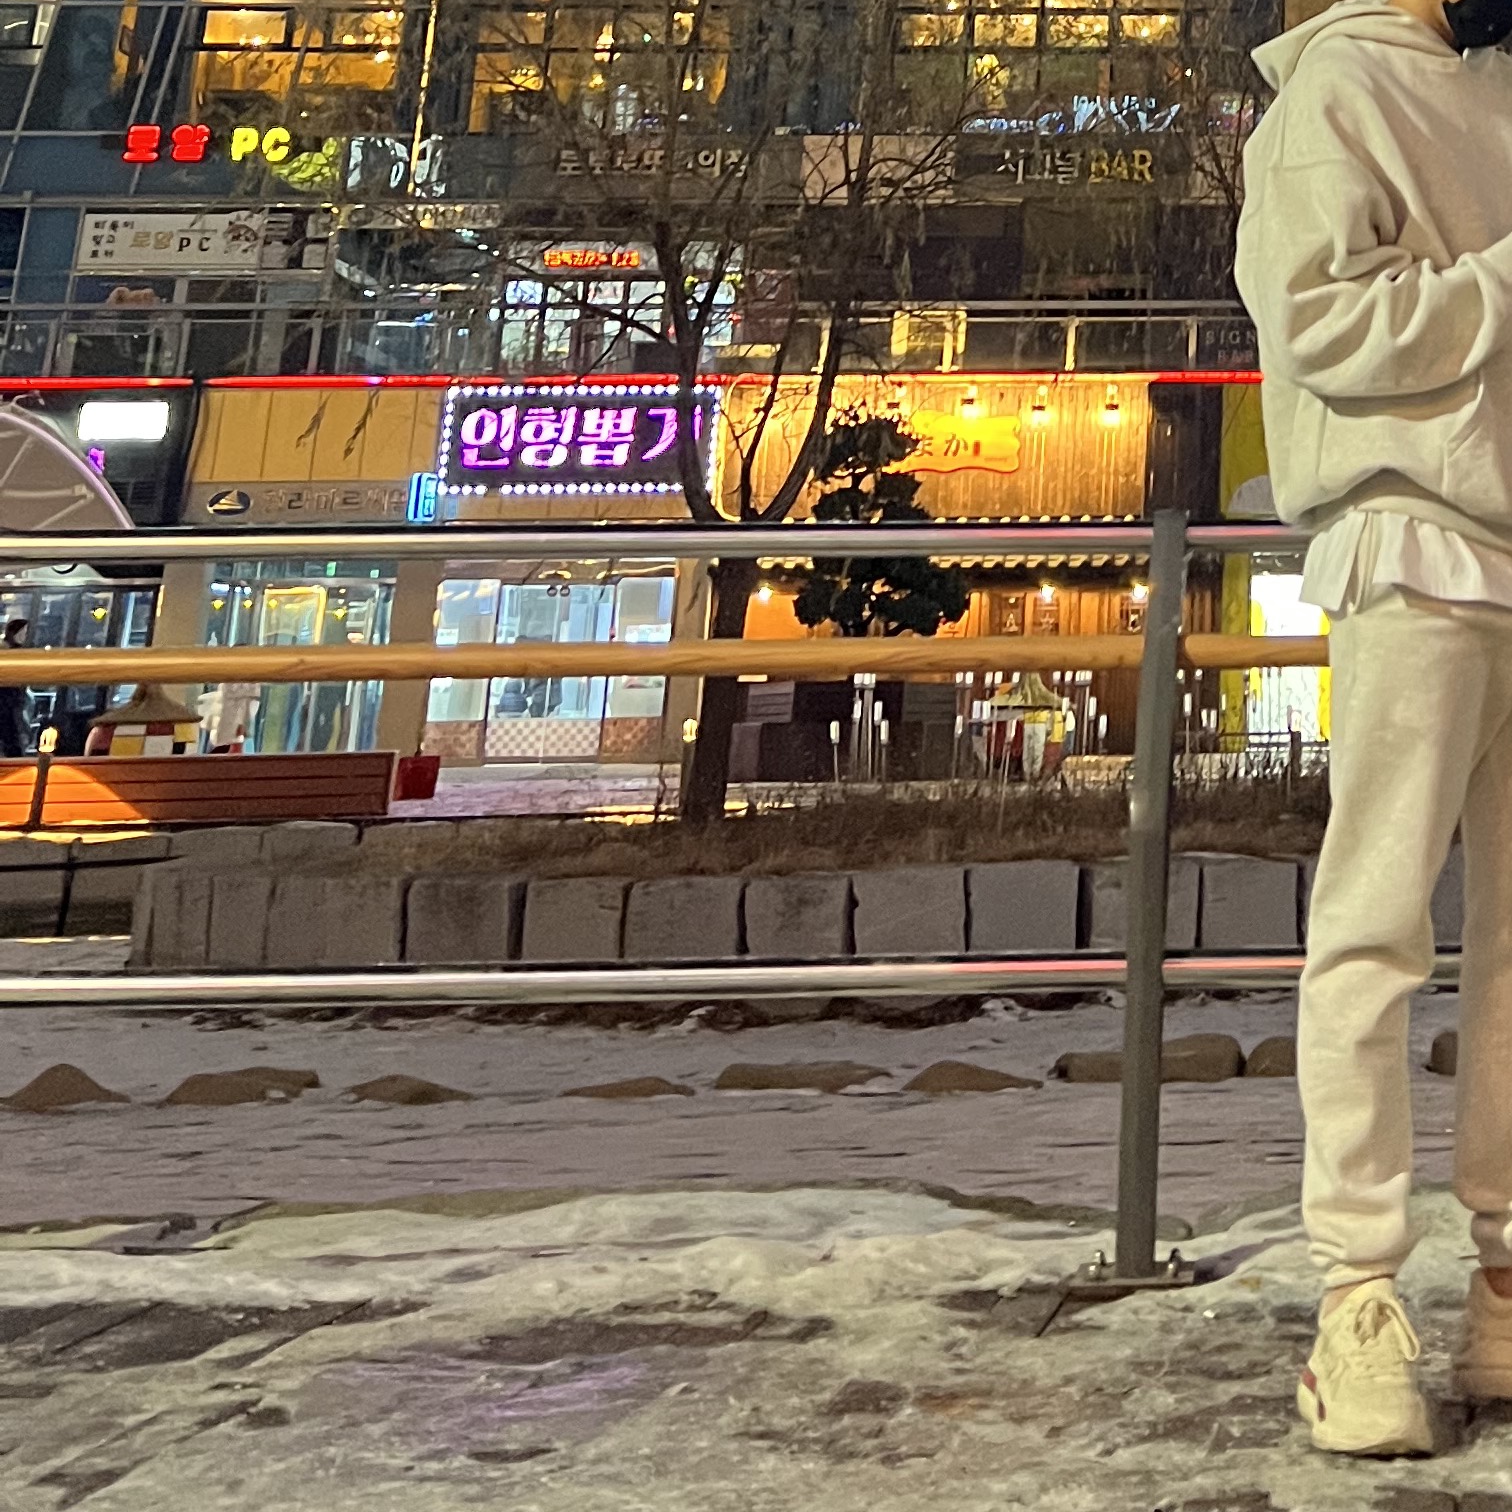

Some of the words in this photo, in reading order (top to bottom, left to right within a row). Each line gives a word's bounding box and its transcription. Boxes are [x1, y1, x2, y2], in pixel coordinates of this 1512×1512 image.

[230, 125, 292, 164] PC
[1087, 148, 1155, 185] BAR
[177, 233, 213, 254] PC
[459, 403, 702, 469] 인형뽑기
